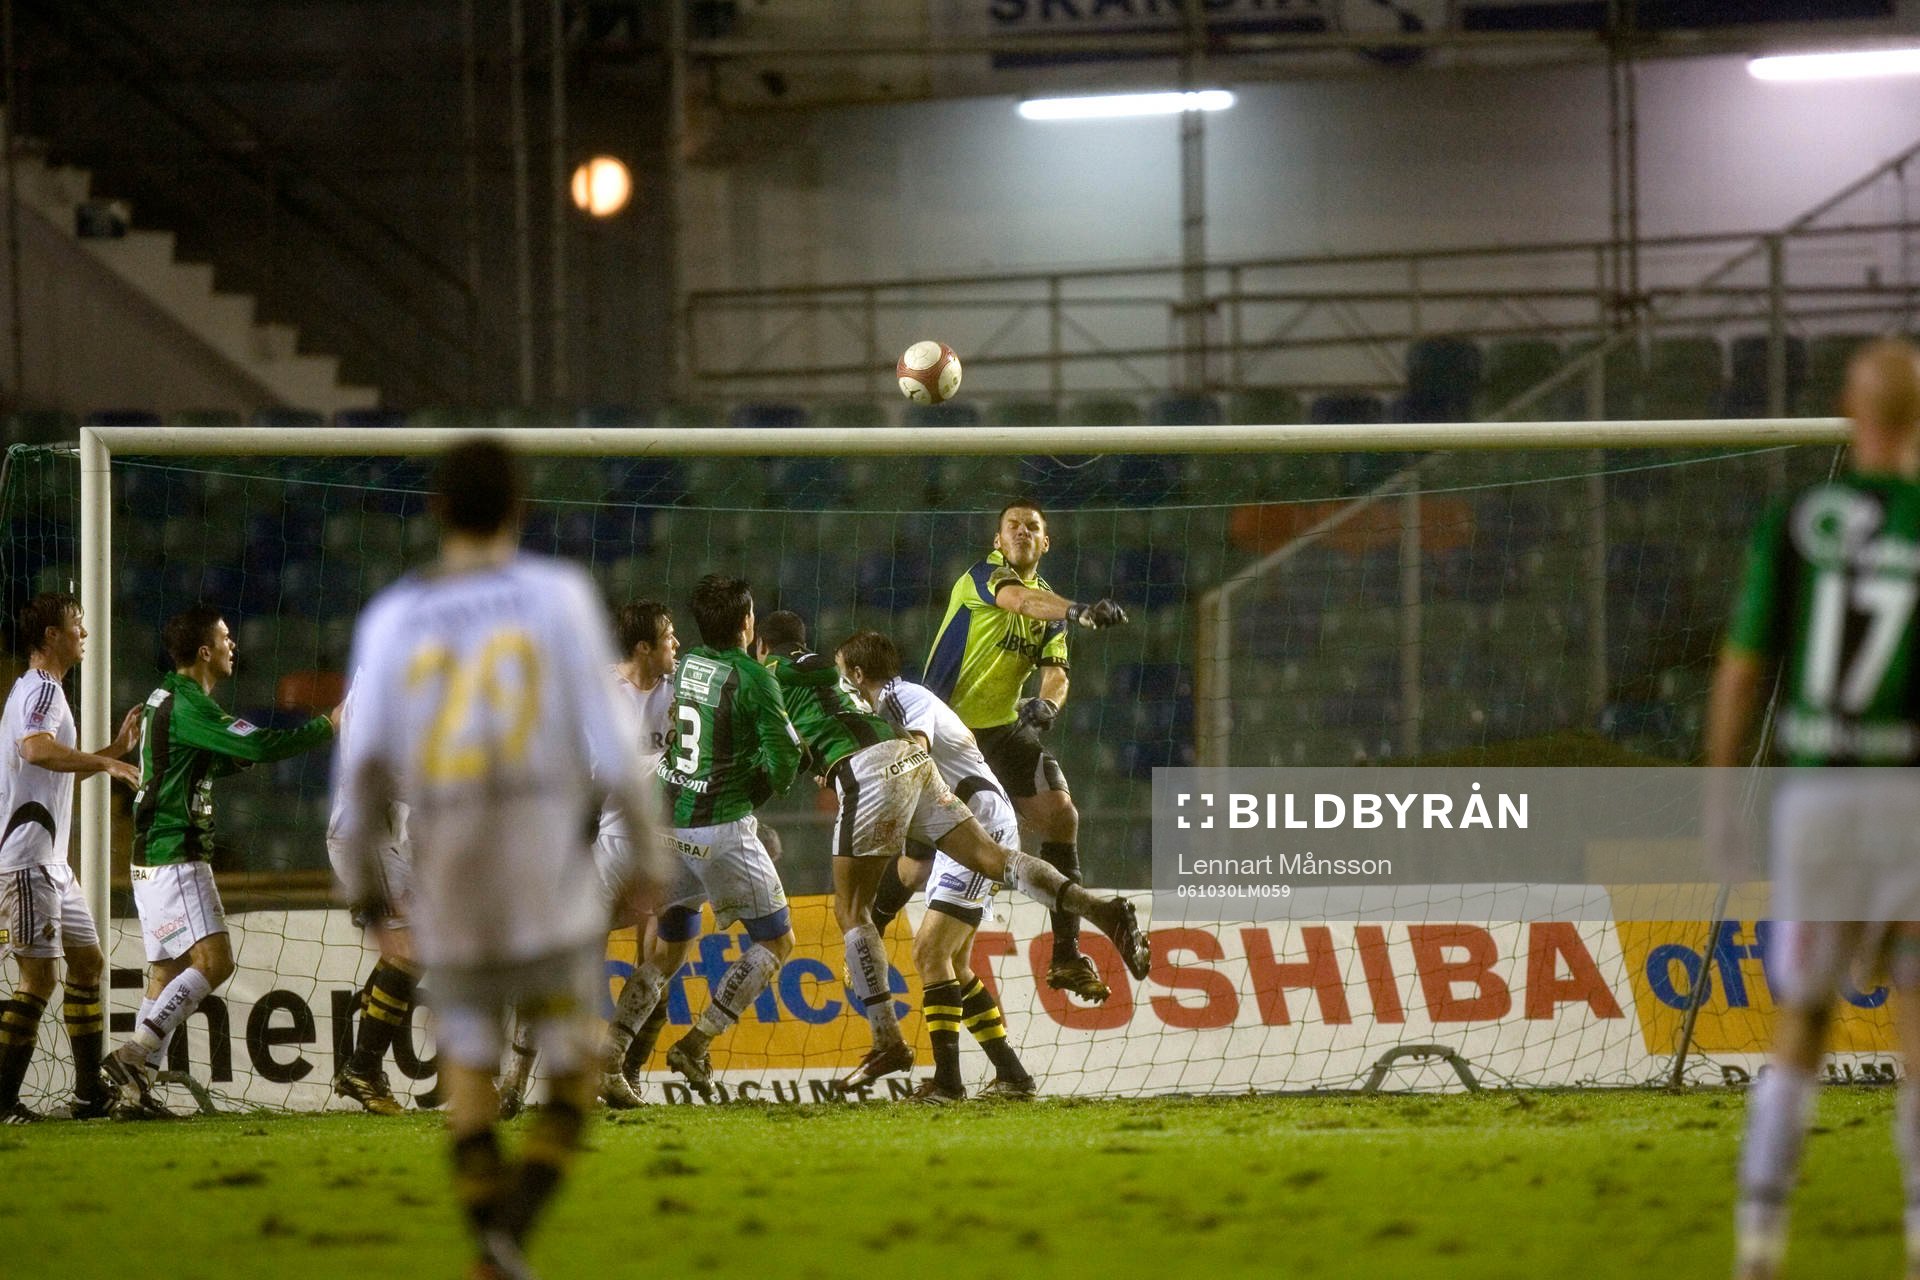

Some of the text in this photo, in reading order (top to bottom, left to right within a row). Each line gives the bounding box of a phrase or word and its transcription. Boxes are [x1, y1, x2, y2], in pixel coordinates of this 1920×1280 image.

[1804, 570, 1915, 713] 17
[405, 627, 541, 778] 29
[675, 704, 701, 775] 3
[969, 922, 1625, 1030] TOSHIBA
[662, 1079, 936, 1104] DOCUMEN
